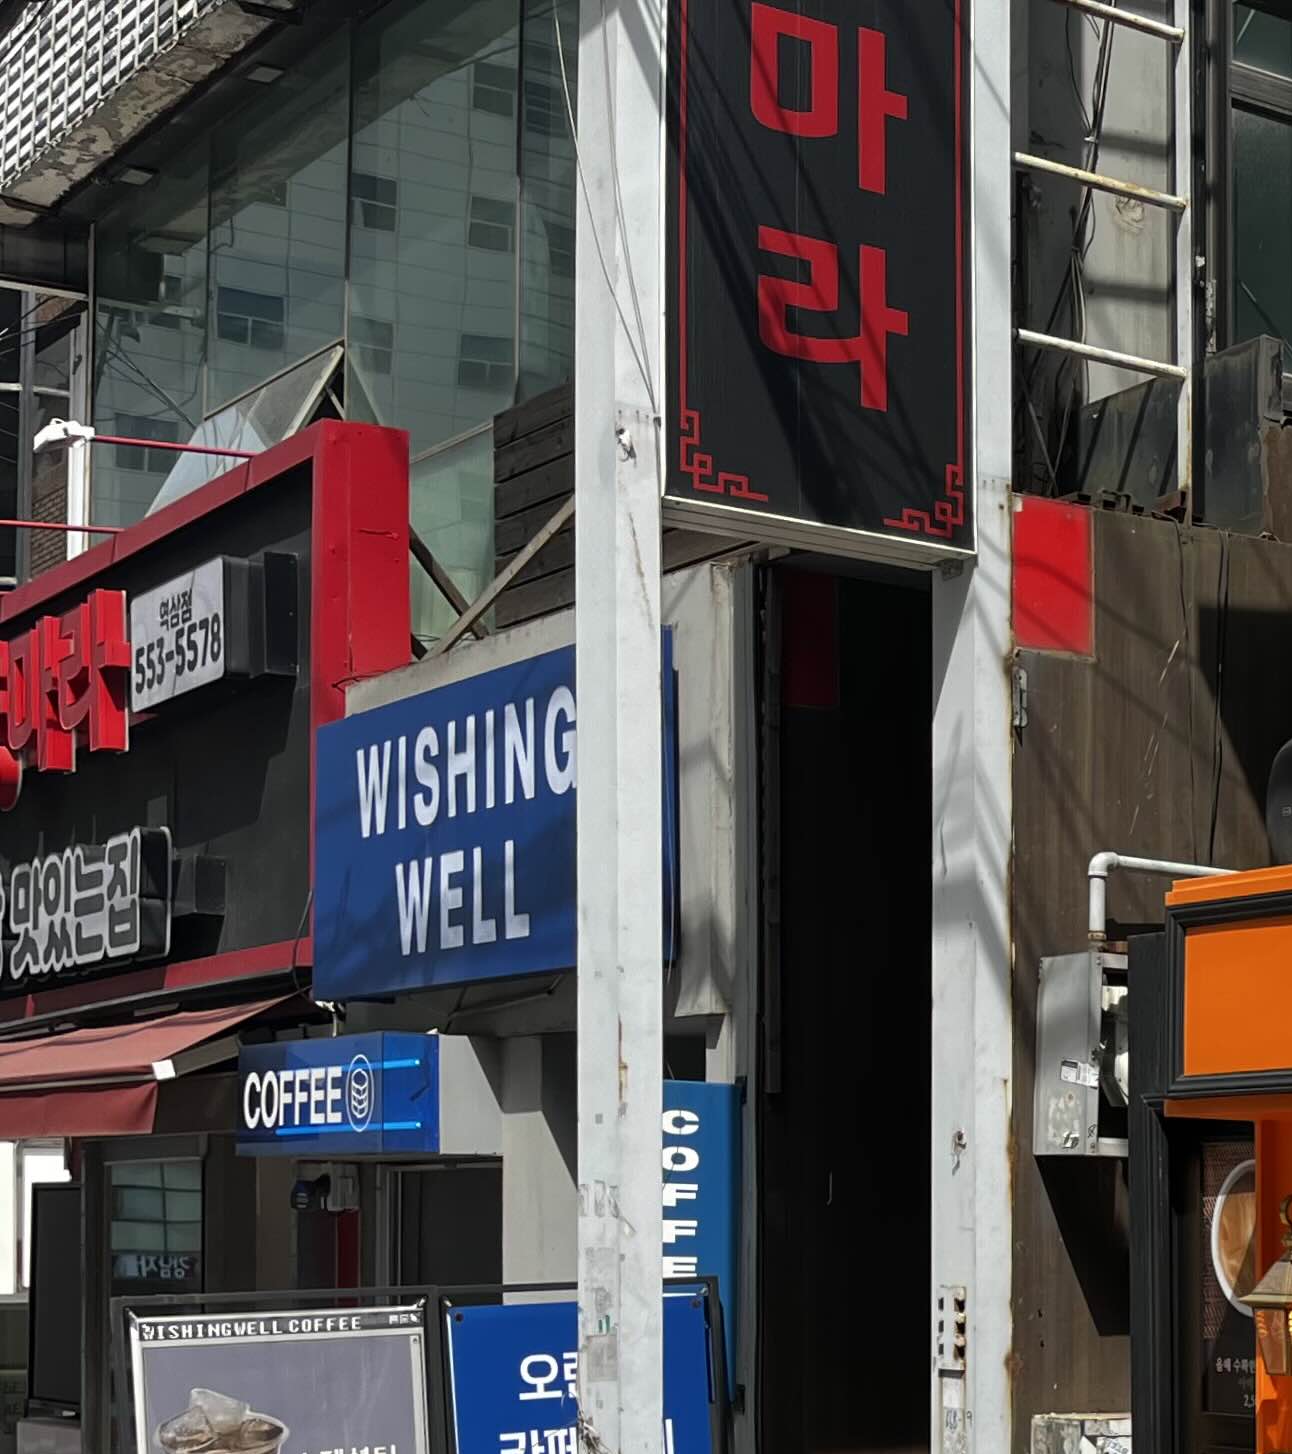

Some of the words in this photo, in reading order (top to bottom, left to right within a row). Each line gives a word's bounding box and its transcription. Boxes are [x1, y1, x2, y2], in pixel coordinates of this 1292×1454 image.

[750, 2, 909, 413] 마라
[134, 612, 222, 694] 553-5578
[159, 587, 193, 630] 역삼점
[0, 588, 131, 812] 마라
[356, 685, 578, 839] WISHING
[10, 825, 141, 980] 맛있는집
[395, 839, 530, 956] WELL
[243, 1066, 343, 1129] COFFEE
[661, 1109, 700, 1297] COFFE
[141, 1321, 283, 1342] WISHINGWELL
[288, 1316, 361, 1333] COFFEE
